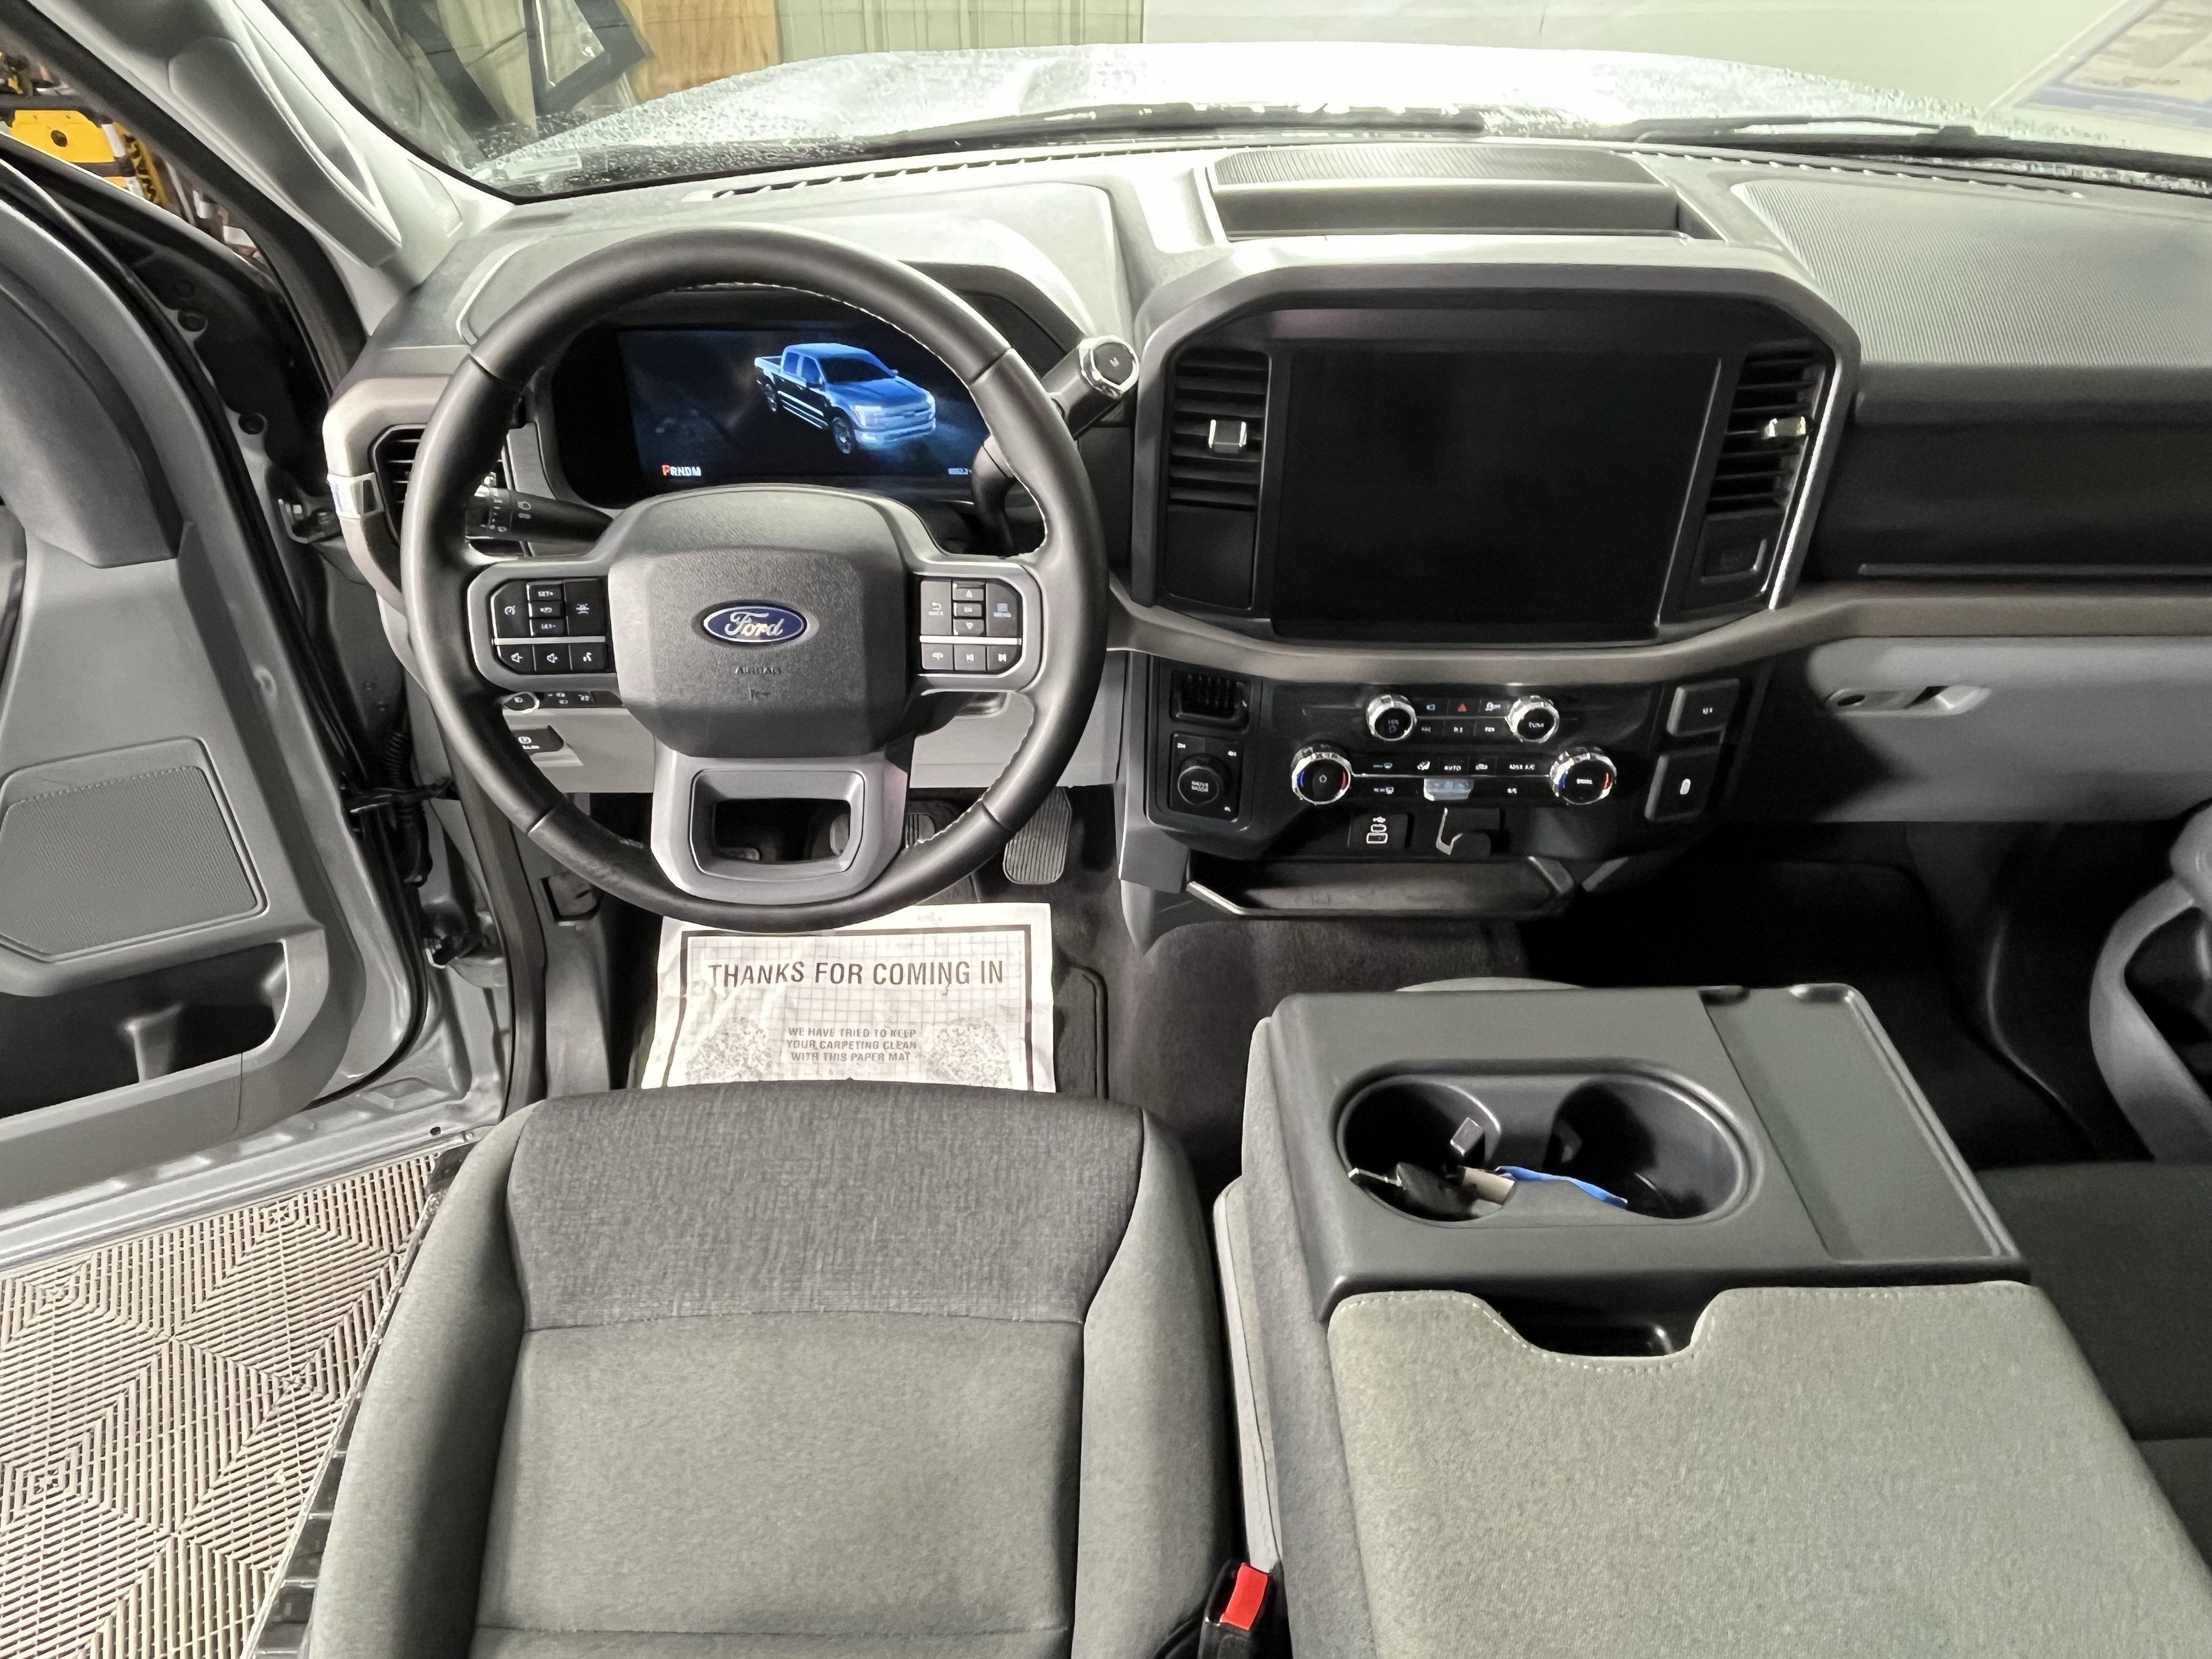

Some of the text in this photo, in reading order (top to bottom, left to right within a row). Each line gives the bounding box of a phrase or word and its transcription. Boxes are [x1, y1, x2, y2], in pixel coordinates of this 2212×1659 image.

[123, 134, 157, 203] WALT
[725, 611, 785, 636] Ford
[708, 961, 1002, 988] THANKS FOR COMING IN
[789, 1028, 916, 1038] WE HAVE TRIED TO KEEP
[787, 1040, 916, 1050] YOUR CARPETING CLEAN
[791, 1051, 910, 1062] WITH THIS PAPER MAT
